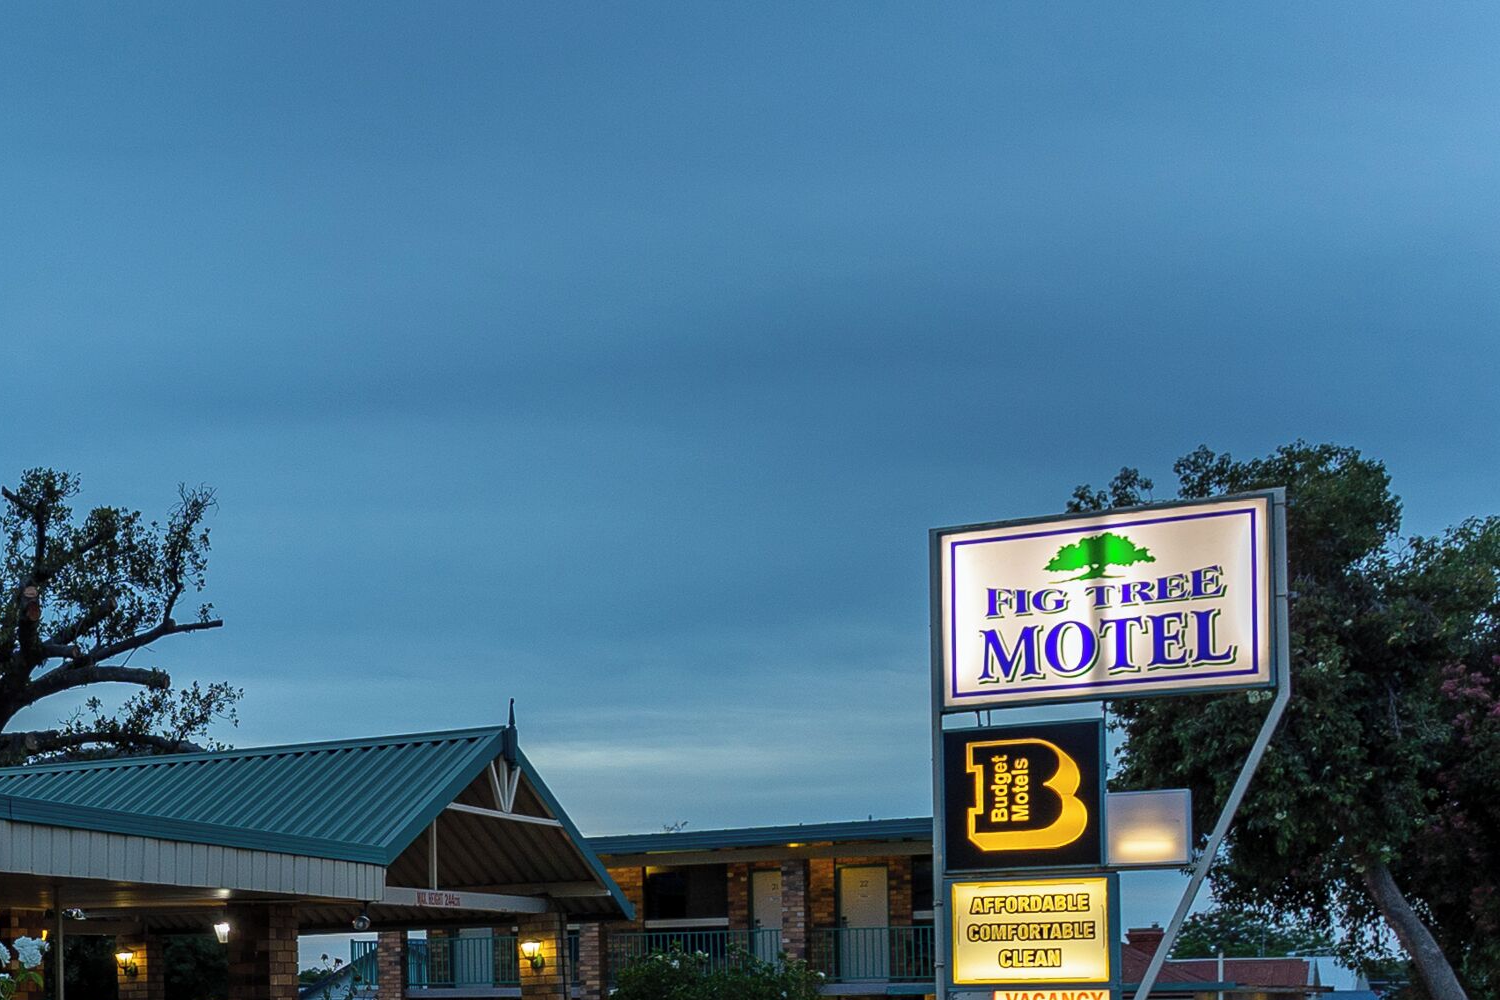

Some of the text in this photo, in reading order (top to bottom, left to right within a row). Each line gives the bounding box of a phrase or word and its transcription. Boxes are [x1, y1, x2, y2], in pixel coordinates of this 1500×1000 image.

[986, 564, 1226, 619] FIG TREE
[978, 608, 1238, 685] MOTEL
[991, 754, 1009, 823] Budget
[1011, 757, 1029, 822] Motels
[859, 879, 869, 887] 22
[969, 893, 1090, 915] AFFORDABLE
[967, 921, 1095, 942] COMFORTABLE
[998, 948, 1062, 968] CLEAN
